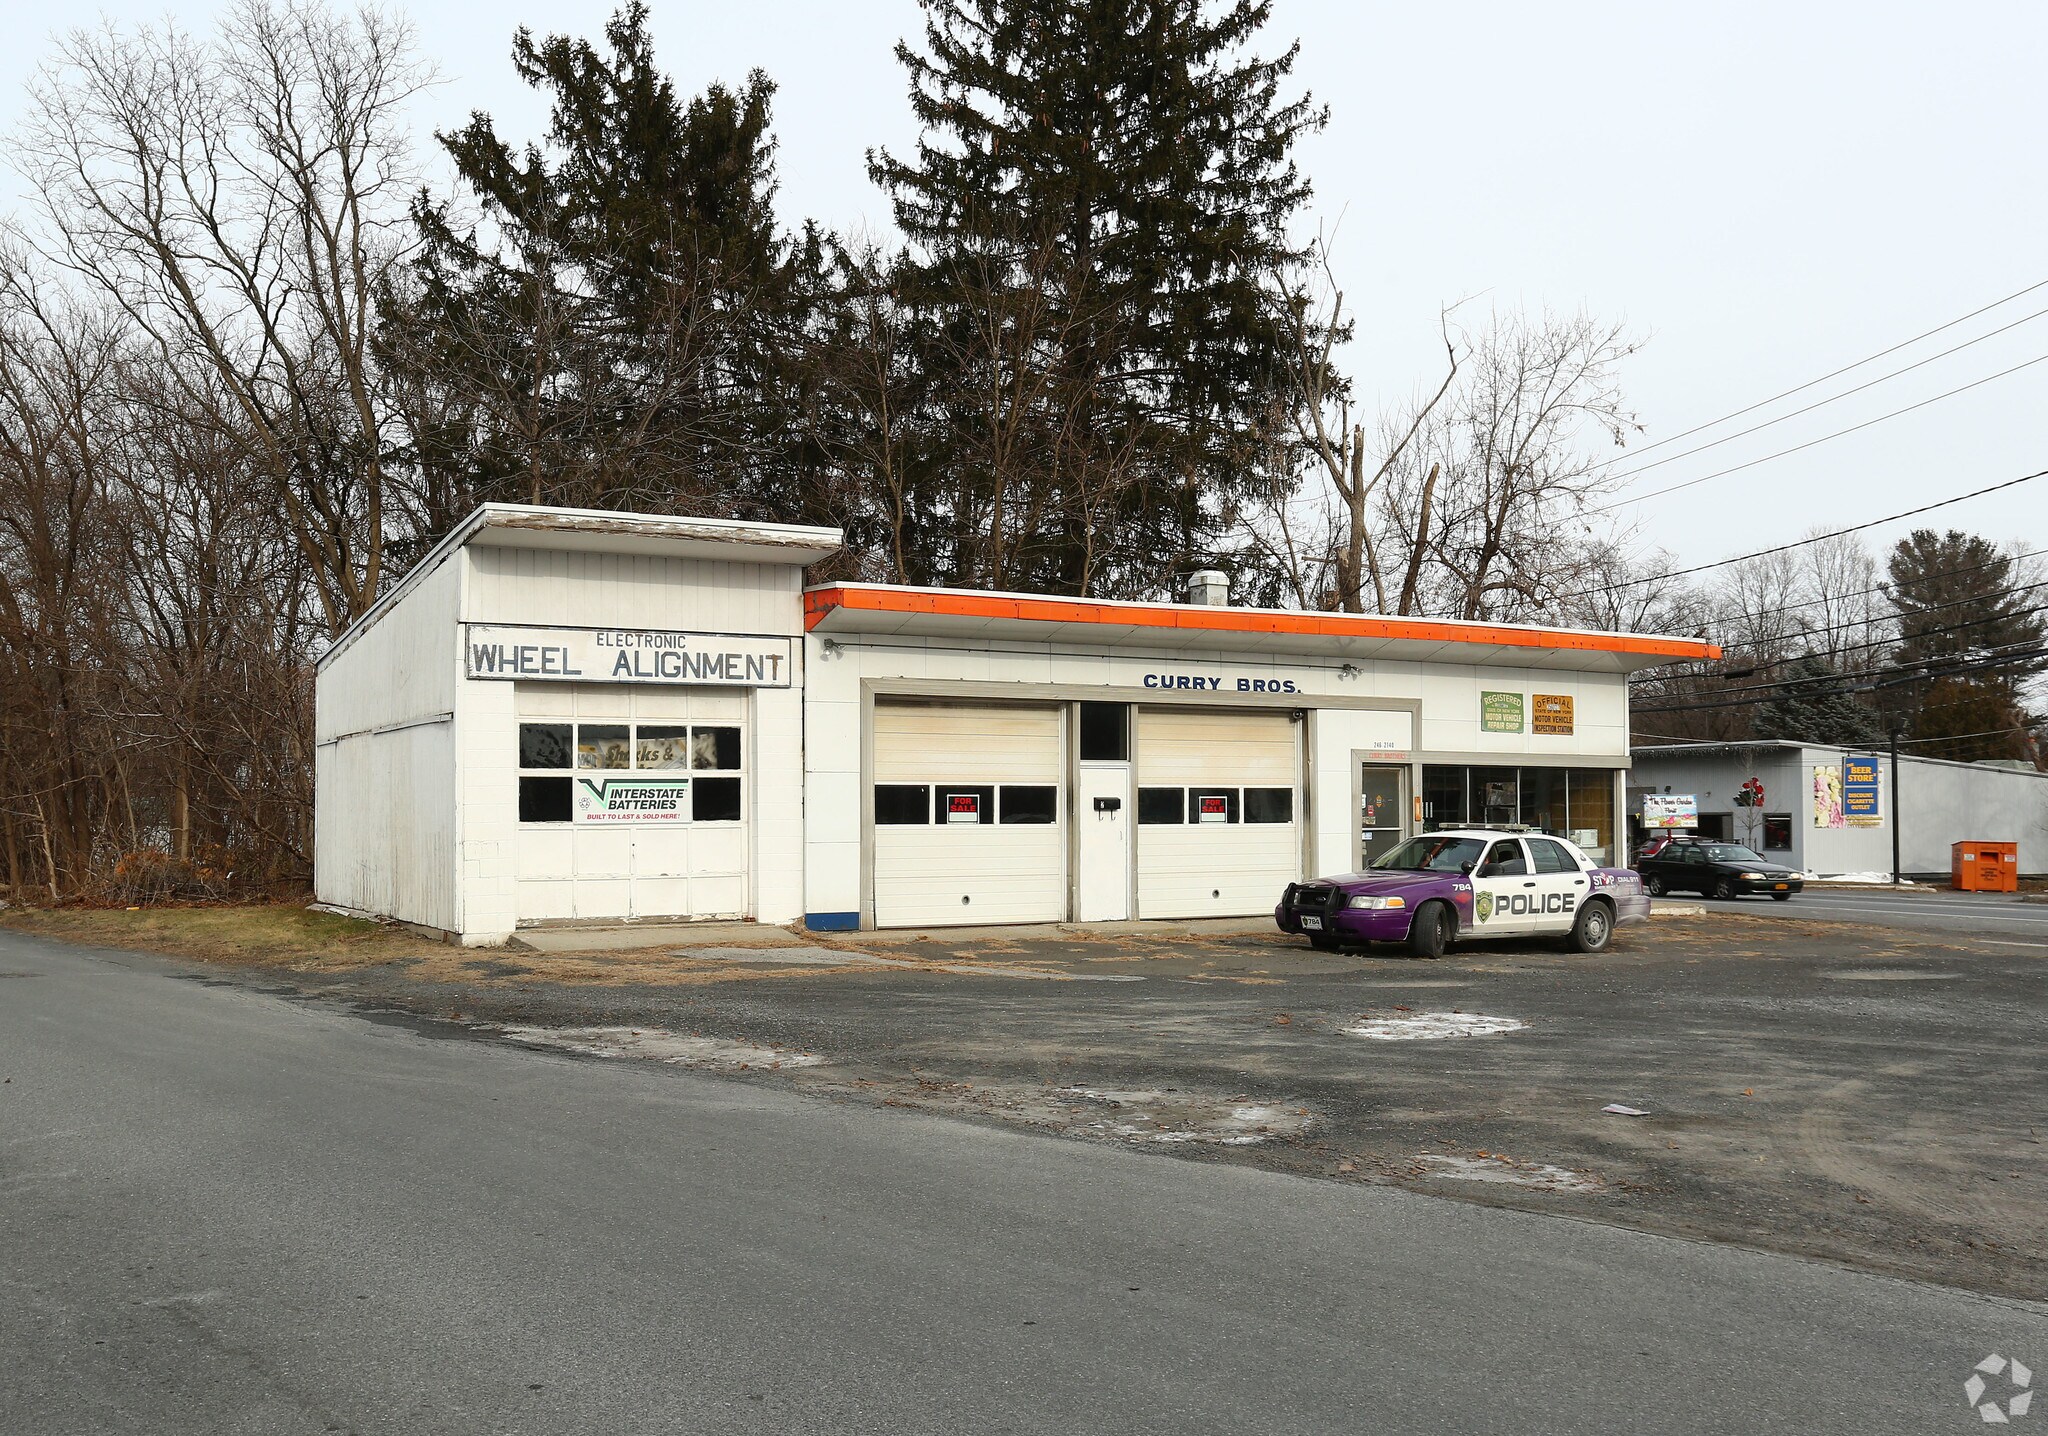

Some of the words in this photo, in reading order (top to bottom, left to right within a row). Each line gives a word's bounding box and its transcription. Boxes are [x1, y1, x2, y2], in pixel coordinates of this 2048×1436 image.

[597, 632, 686, 649] ELECTRONIC
[473, 643, 582, 676] WHEEL
[612, 649, 784, 681] ALIGNMENT
[1143, 674, 1222, 690] CURRY
[1237, 678, 1302, 693] BROS.
[1484, 694, 1522, 707] REGISTERED
[1536, 697, 1571, 709] OFFICIAL
[1485, 713, 1502, 721] MOTOR
[1503, 714, 1522, 722] VEHICLE
[1535, 715, 1551, 723] MOTOR
[1552, 716, 1573, 724] VEHICLE
[1506, 722, 1520, 730] SHOP
[662, 747, 673, 761] &
[1847, 774, 1874, 782] STORE
[610, 788, 684, 799] INTERSTATE
[608, 799, 677, 810] BATTERIES
[1452, 883, 1472, 891] 784
[1495, 893, 1575, 915] POLICE
